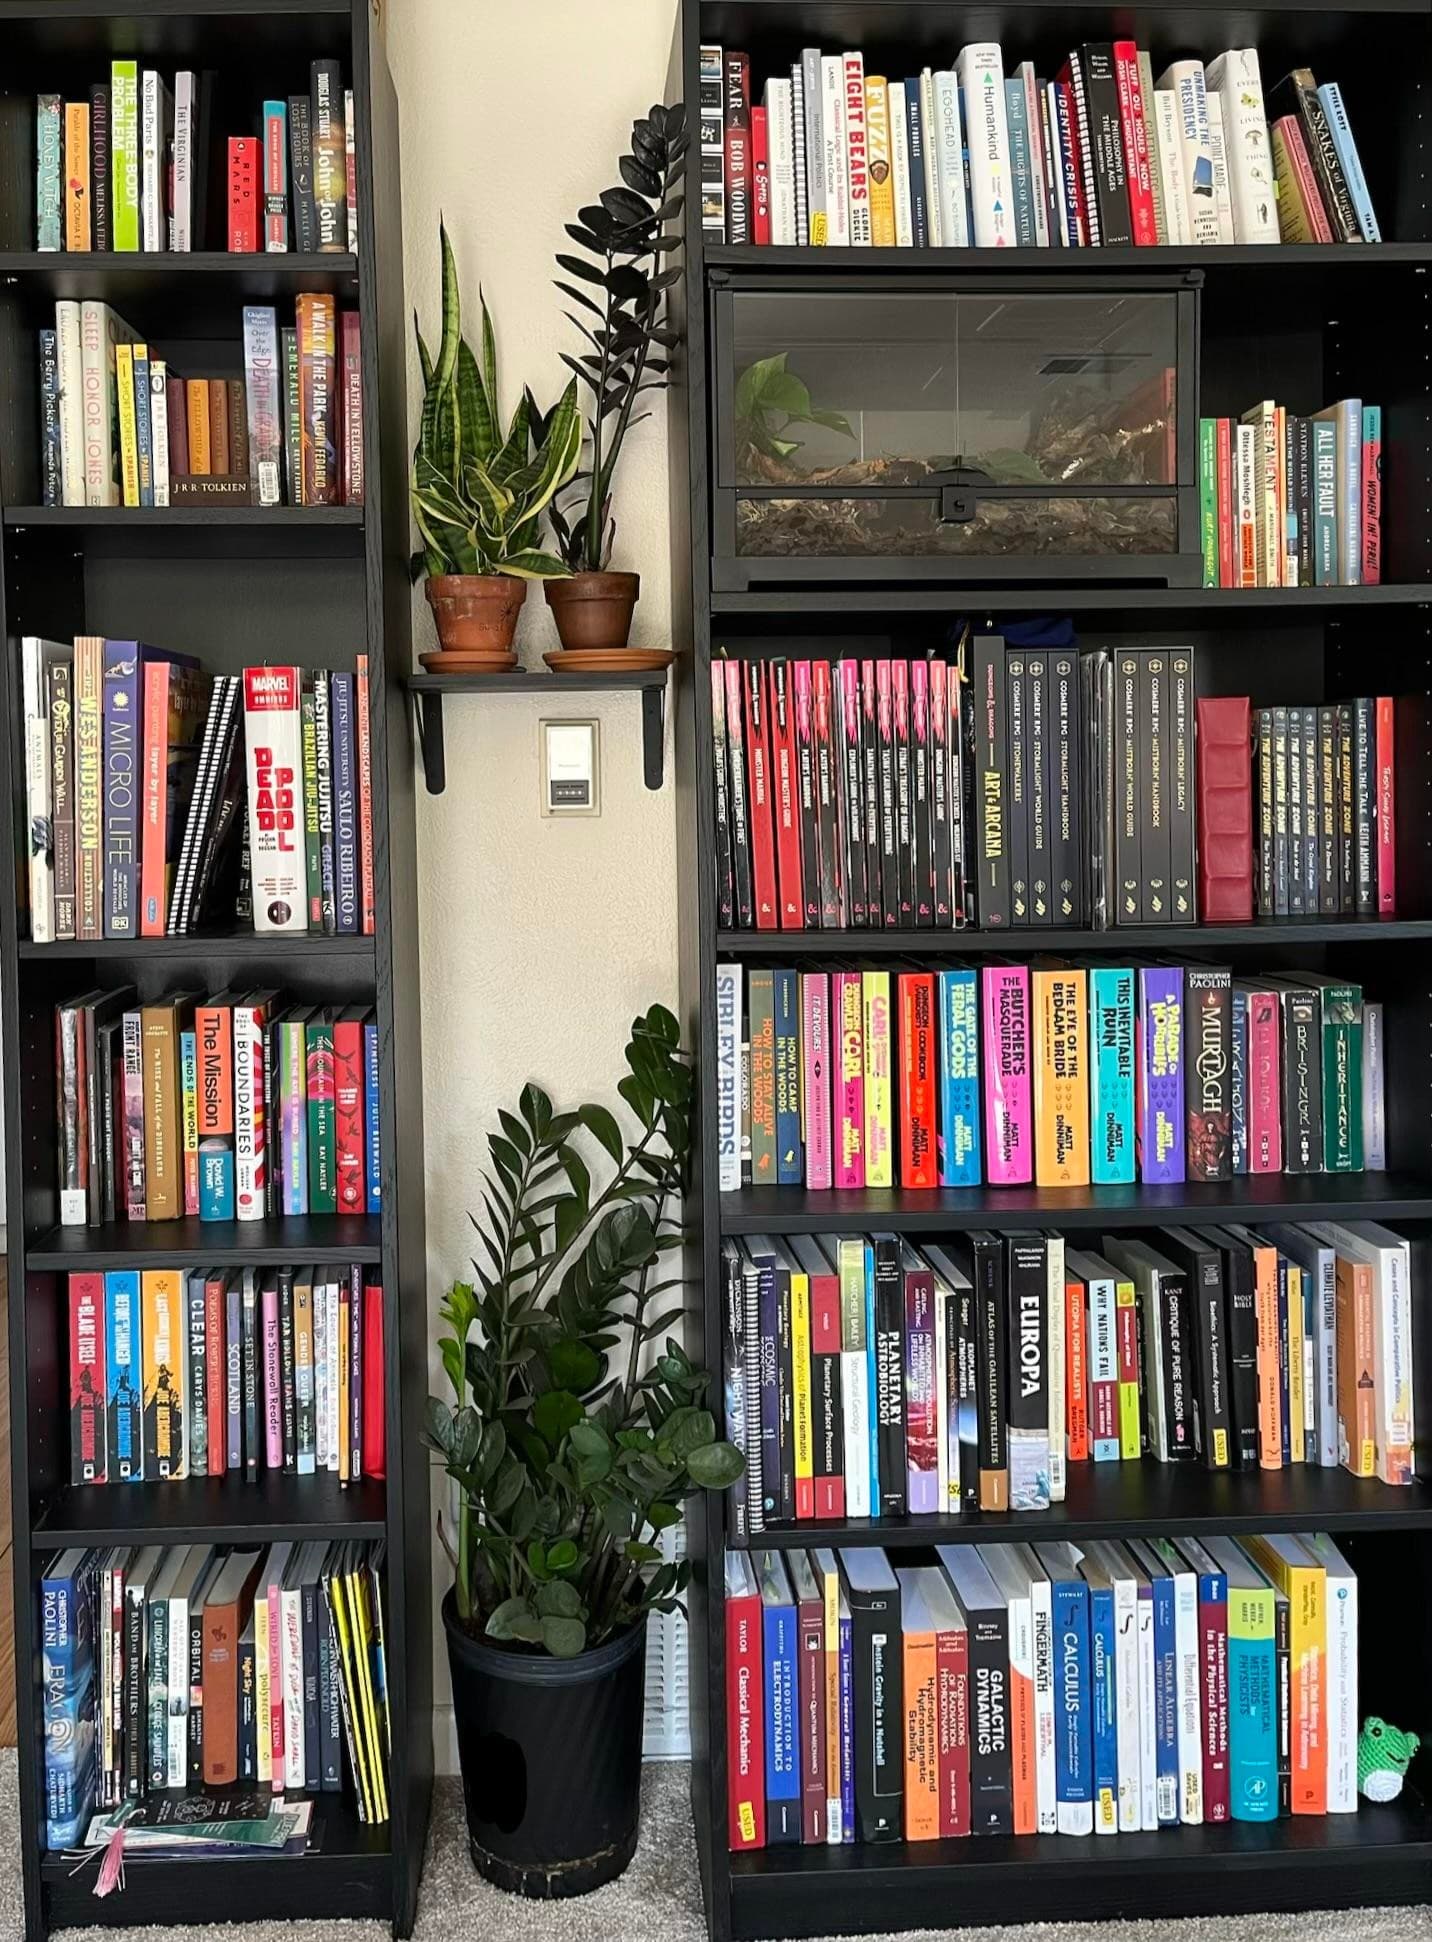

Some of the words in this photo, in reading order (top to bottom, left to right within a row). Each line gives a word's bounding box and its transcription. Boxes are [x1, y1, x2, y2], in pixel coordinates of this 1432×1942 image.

[124, 76, 135, 105] THE
[145, 79, 153, 93] No
[145, 95, 153, 115] Bad
[318, 73, 329, 107] DOUGLAS
[728, 61, 742, 109] FEAR
[846, 61, 864, 124] EIGHT
[112, 76, 125, 150] PROBLEM
[319, 110, 331, 139] STUART
[866, 85, 886, 159] FUZZ
[942, 90, 955, 148] EGGHEAD
[983, 86, 999, 160] Humankind
[1011, 93, 1021, 119] Boyd
[1102, 115, 1111, 131] THE
[1180, 79, 1194, 141] PRESIDENCY
[1193, 71, 1205, 125] UNMAKING
[1200, 129, 1209, 146] THE
[43, 125, 55, 170] HONEY
[93, 92, 106, 179] GIRLHOOD
[145, 117, 154, 144] Parts
[1014, 130, 1023, 150] THE
[1104, 133, 1114, 164] MIDDLE
[1110, 120, 1122, 174] PHILOSOPHY
[125, 111, 138, 207] THREE-BODY
[319, 146, 333, 190] John
[731, 140, 744, 173] BOB
[849, 131, 867, 200] BEARS
[1014, 152, 1026, 187] RIGHTS
[1058, 94, 1074, 160] IDENTITY
[1067, 162, 1078, 209] CRISIS
[1311, 111, 1337, 171] SNAKES
[1333, 173, 1342, 183] of
[1338, 189, 1357, 231] Virginia
[44, 173, 55, 218] WITCH
[1019, 190, 1026, 202] OF
[1107, 167, 1117, 191] AGES
[1115, 175, 1123, 185] IN
[96, 183, 105, 226] MELISSA
[320, 198, 336, 243] John
[1019, 204, 1030, 243] NATURE
[45, 336, 54, 356] The
[84, 311, 98, 351] SLEEP
[312, 311, 326, 342] WALK
[312, 345, 326, 357] IN
[312, 359, 325, 380] THE
[43, 359, 55, 389] Berry
[350, 373, 360, 405] DEATH
[45, 393, 56, 432] Pickers
[86, 367, 100, 426] HONOR
[312, 384, 326, 412] PARK
[351, 408, 361, 418] IN
[314, 421, 326, 446] KEVIN
[1242, 432, 1250, 463] Ottessa
[1265, 413, 1276, 493] TESTAMENT
[1318, 430, 1333, 452] ALL
[88, 436, 102, 485] JONES
[314, 449, 326, 488] FEDARKO
[351, 422, 361, 493] YELLOWSTONE
[1319, 456, 1333, 479] HER
[200, 483, 246, 492] TOLKIEN
[1242, 466, 1251, 505] Moshfegh
[1319, 482, 1333, 517] FAULT
[1367, 480, 1376, 520] WOMEN!
[1368, 522, 1377, 536] IN!
[1368, 541, 1377, 569] PERIL!
[253, 675, 289, 691] MARVEL
[1013, 681, 1021, 718] COSMERE
[80, 696, 96, 738] WES
[337, 679, 348, 728] JIU-JITSU
[315, 681, 328, 769] MASTERING
[1342, 736, 1350, 752] THE
[110, 721, 132, 807] MICRO
[304, 724, 315, 779] BRAZILIAN
[340, 730, 349, 786] UNIVERSITY
[80, 745, 98, 849] ANDERSON
[307, 782, 317, 832] JIU-JITSU
[320, 774, 331, 832] JUJITSU
[339, 790, 352, 839] SAULO
[985, 804, 1001, 857] ARCANA
[1343, 806, 1351, 833] ZONE
[110, 817, 131, 864] LIFE
[322, 845, 333, 891] GRACIE
[341, 844, 353, 912] RIBEIRO
[1066, 983, 1076, 1006] THE
[1118, 978, 1130, 1004] THIS
[1189, 980, 1231, 989] PAOLINI
[952, 985, 965, 1028] FERAL
[1053, 983, 1064, 1035] BEDLAM
[1066, 1009, 1076, 1029] EYE
[204, 1014, 220, 1050] The
[1000, 989, 1013, 1077] MASQUERADE
[1011, 989, 1025, 1075] BUTCHER'S
[1067, 1035, 1076, 1052] OF
[1102, 1008, 1117, 1047] RUIN
[1118, 1006, 1131, 1078] INEVITABLE
[1166, 1003, 1179, 1063] PARADE
[787, 1037, 797, 1059] HOW
[843, 1032, 861, 1082] CARL
[952, 1031, 965, 1079] GODS
[1054, 1041, 1066, 1079] BRIDE
[1068, 1056, 1077, 1078] THE
[1197, 1006, 1226, 1113] MURTAGH
[204, 1054, 221, 1127] Mission
[788, 1062, 797, 1079] TO
[1296, 1026, 1310, 1125] BRISINGR
[1337, 1029, 1347, 1148] INHERITANCE
[237, 1040, 251, 1154] BOUNDARIES
[788, 1082, 797, 1112] CAMP
[1056, 1115, 1065, 1164] DINNIMAN
[1064, 1126, 1073, 1150] MATT
[319, 1162, 327, 1191] NAYLER
[960, 1298, 970, 1326] Seager
[1071, 1295, 1081, 1330] UTOPIA
[1097, 1286, 1108, 1309] WHY
[1169, 1295, 1180, 1339] CRITIQUE
[191, 1300, 205, 1355] CLEAR
[268, 1320, 276, 1338] The
[1020, 1295, 1040, 1397] EUROPA
[1072, 1333, 1081, 1353] FOR
[1097, 1314, 1109, 1353] NATIONS
[1171, 1342, 1181, 1352] OF
[194, 1366, 203, 1398] CARYS
[228, 1343, 240, 1414] SCOTLAND
[246, 1359, 255, 1369] IN
[268, 1341, 278, 1395] Stonewall
[823, 1358, 833, 1397] Planetary
[878, 1333, 889, 1425] ASTROBIOLOGY
[888, 1332, 901, 1424] PLANETARY
[1072, 1355, 1082, 1399] REALISTS
[1099, 1357, 1109, 1376] FAIL
[1172, 1355, 1182, 1380] PURE
[246, 1371, 255, 1408] STONE
[1173, 1383, 1184, 1420] REASON
[195, 1401, 204, 1435] DAVIES
[270, 1397, 278, 1436] Reader
[825, 1399, 834, 1430] Surface
[825, 1432, 834, 1472] Processes
[1215, 1433, 1226, 1460] USED
[44, 1592, 57, 1647] PAOLINI
[739, 1619, 748, 1652] TAYLOR
[190, 1630, 201, 1681] ORBITAL
[1036, 1612, 1048, 1693] FINGERMATH
[1064, 1633, 1079, 1711] CALCULUS
[1165, 1652, 1174, 1692] LINEAR
[739, 1667, 750, 1714] Classical
[991, 1670, 1004, 1751] GALACTIC
[773, 1661, 784, 1772] ELECTRODYNAMICS
[977, 1669, 991, 1754] DYNAMICS
[1165, 1696, 1175, 1747] ALGEBRA
[740, 1717, 750, 1775] Mechanics
[908, 1710, 917, 1762] Stability
[742, 1808, 753, 1836] USED
